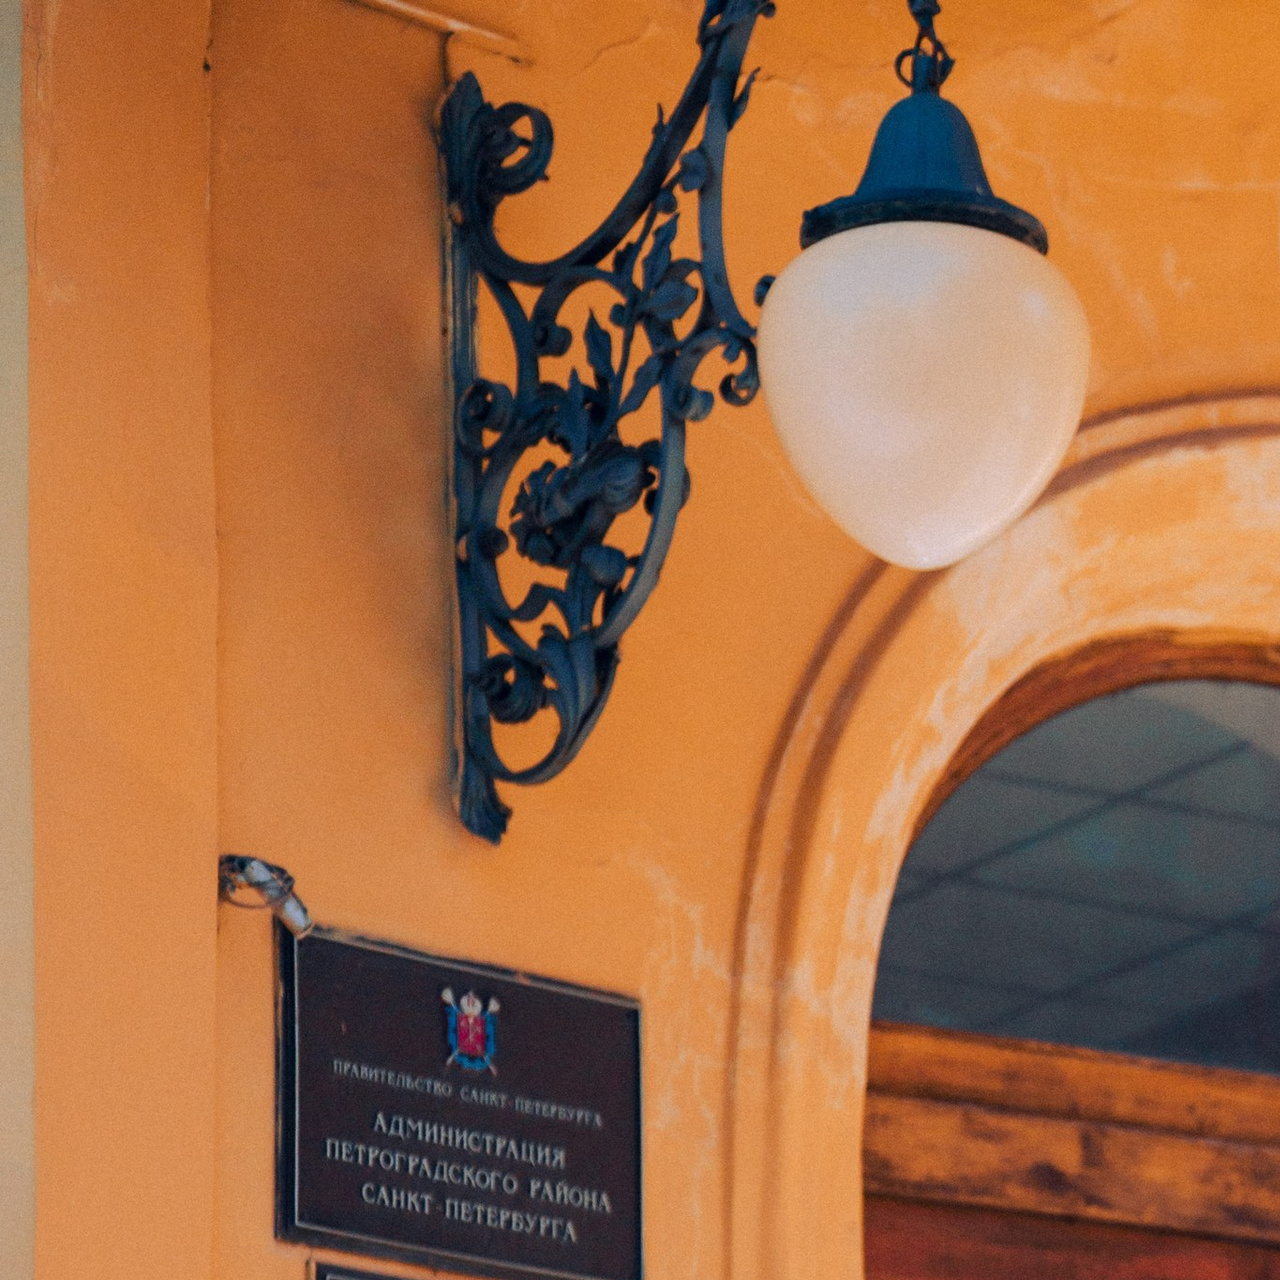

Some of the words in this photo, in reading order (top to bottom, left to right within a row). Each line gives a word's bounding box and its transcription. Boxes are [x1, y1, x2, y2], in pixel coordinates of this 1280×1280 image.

[333, 1058, 451, 1097] ПРАВИТЕЛЬСТВО
[373, 1111, 566, 1169] АДМИНИСТРАЦИЯ
[325, 1138, 518, 1194] ПЕТРОГРАДСКОГО
[530, 1179, 613, 1214] РАЙОНА
